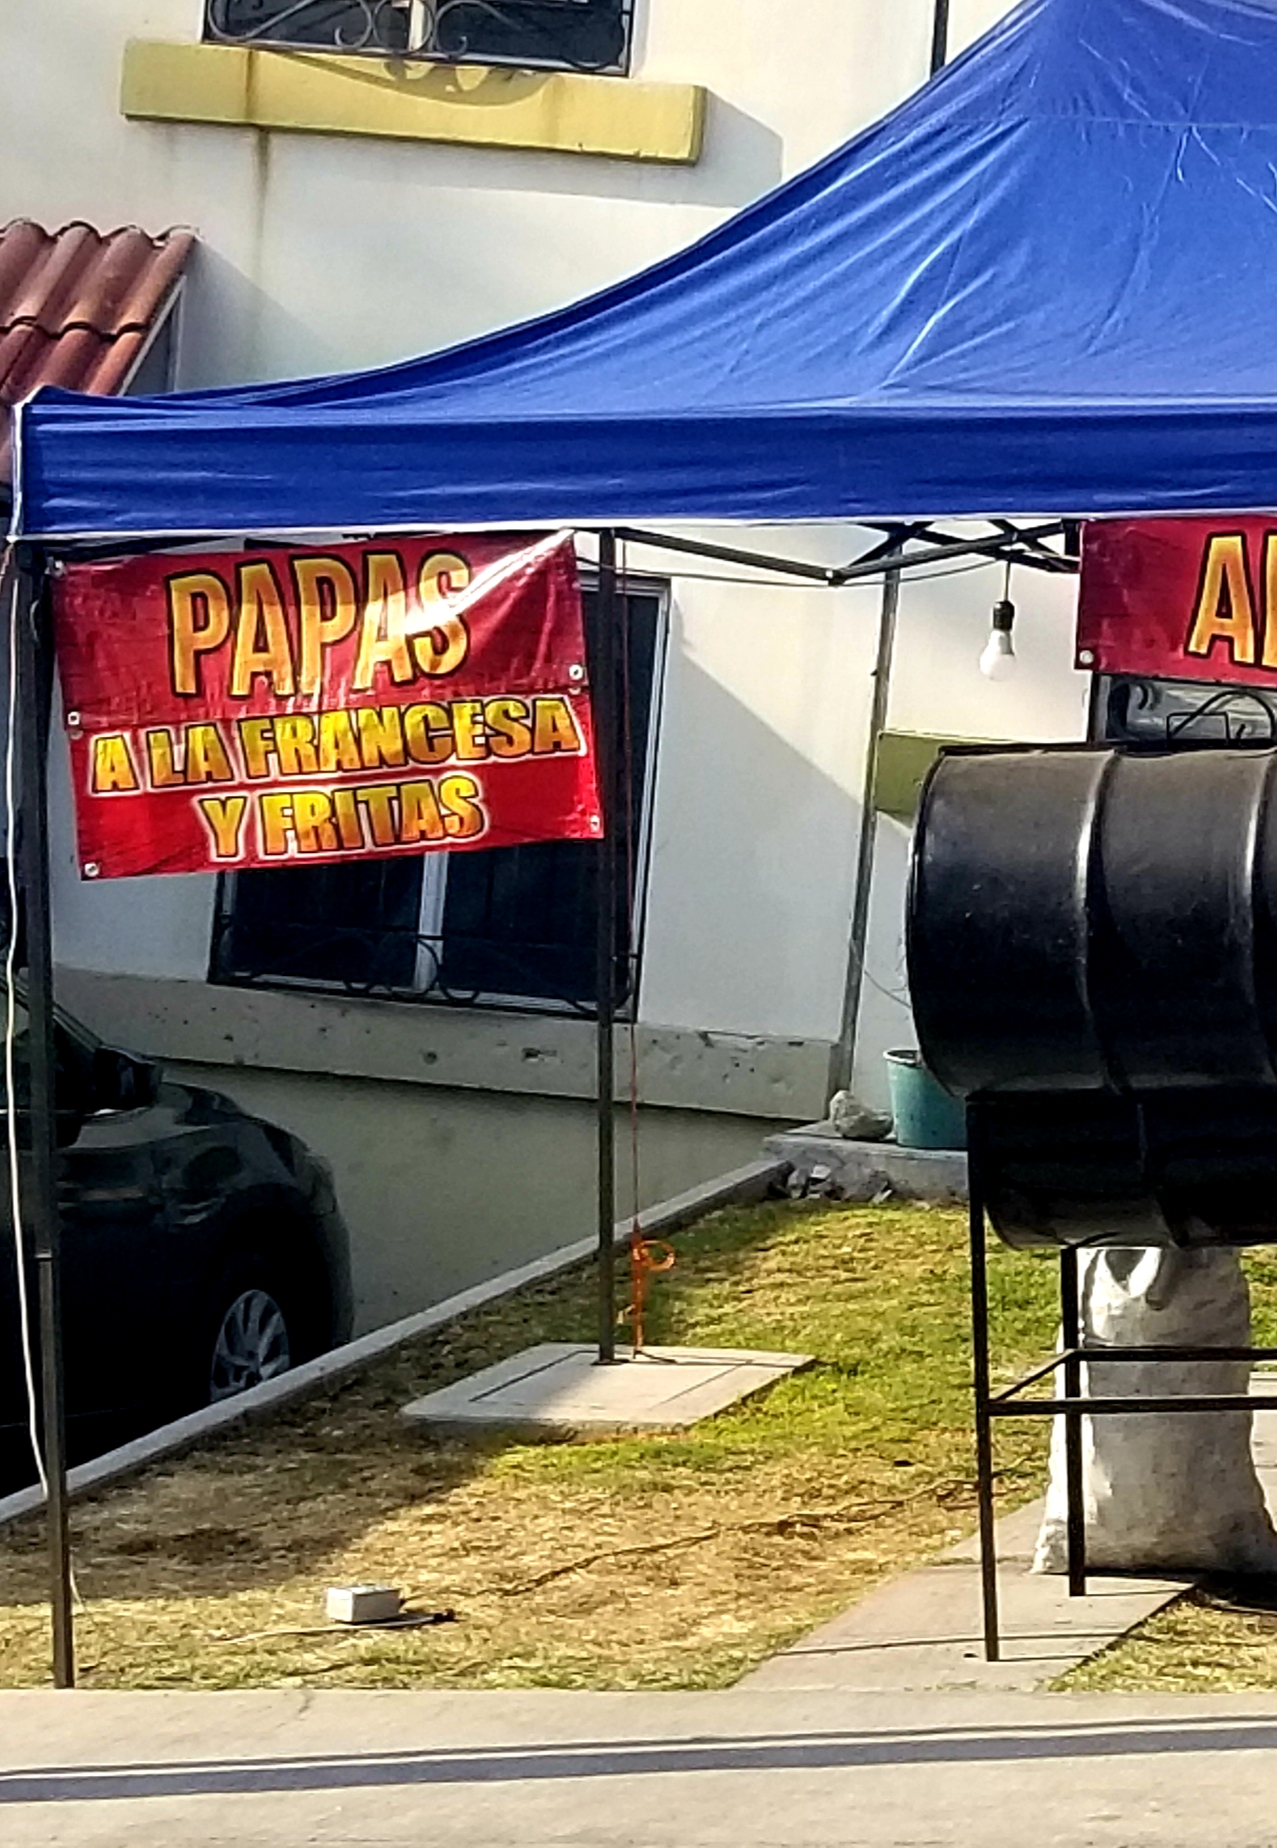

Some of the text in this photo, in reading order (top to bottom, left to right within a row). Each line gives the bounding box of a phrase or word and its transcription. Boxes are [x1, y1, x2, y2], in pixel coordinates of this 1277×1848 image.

[166, 550, 473, 700] PAPAS
[90, 696, 580, 793] A LA FRANCESA
[201, 775, 486, 858] Y FRITAS
